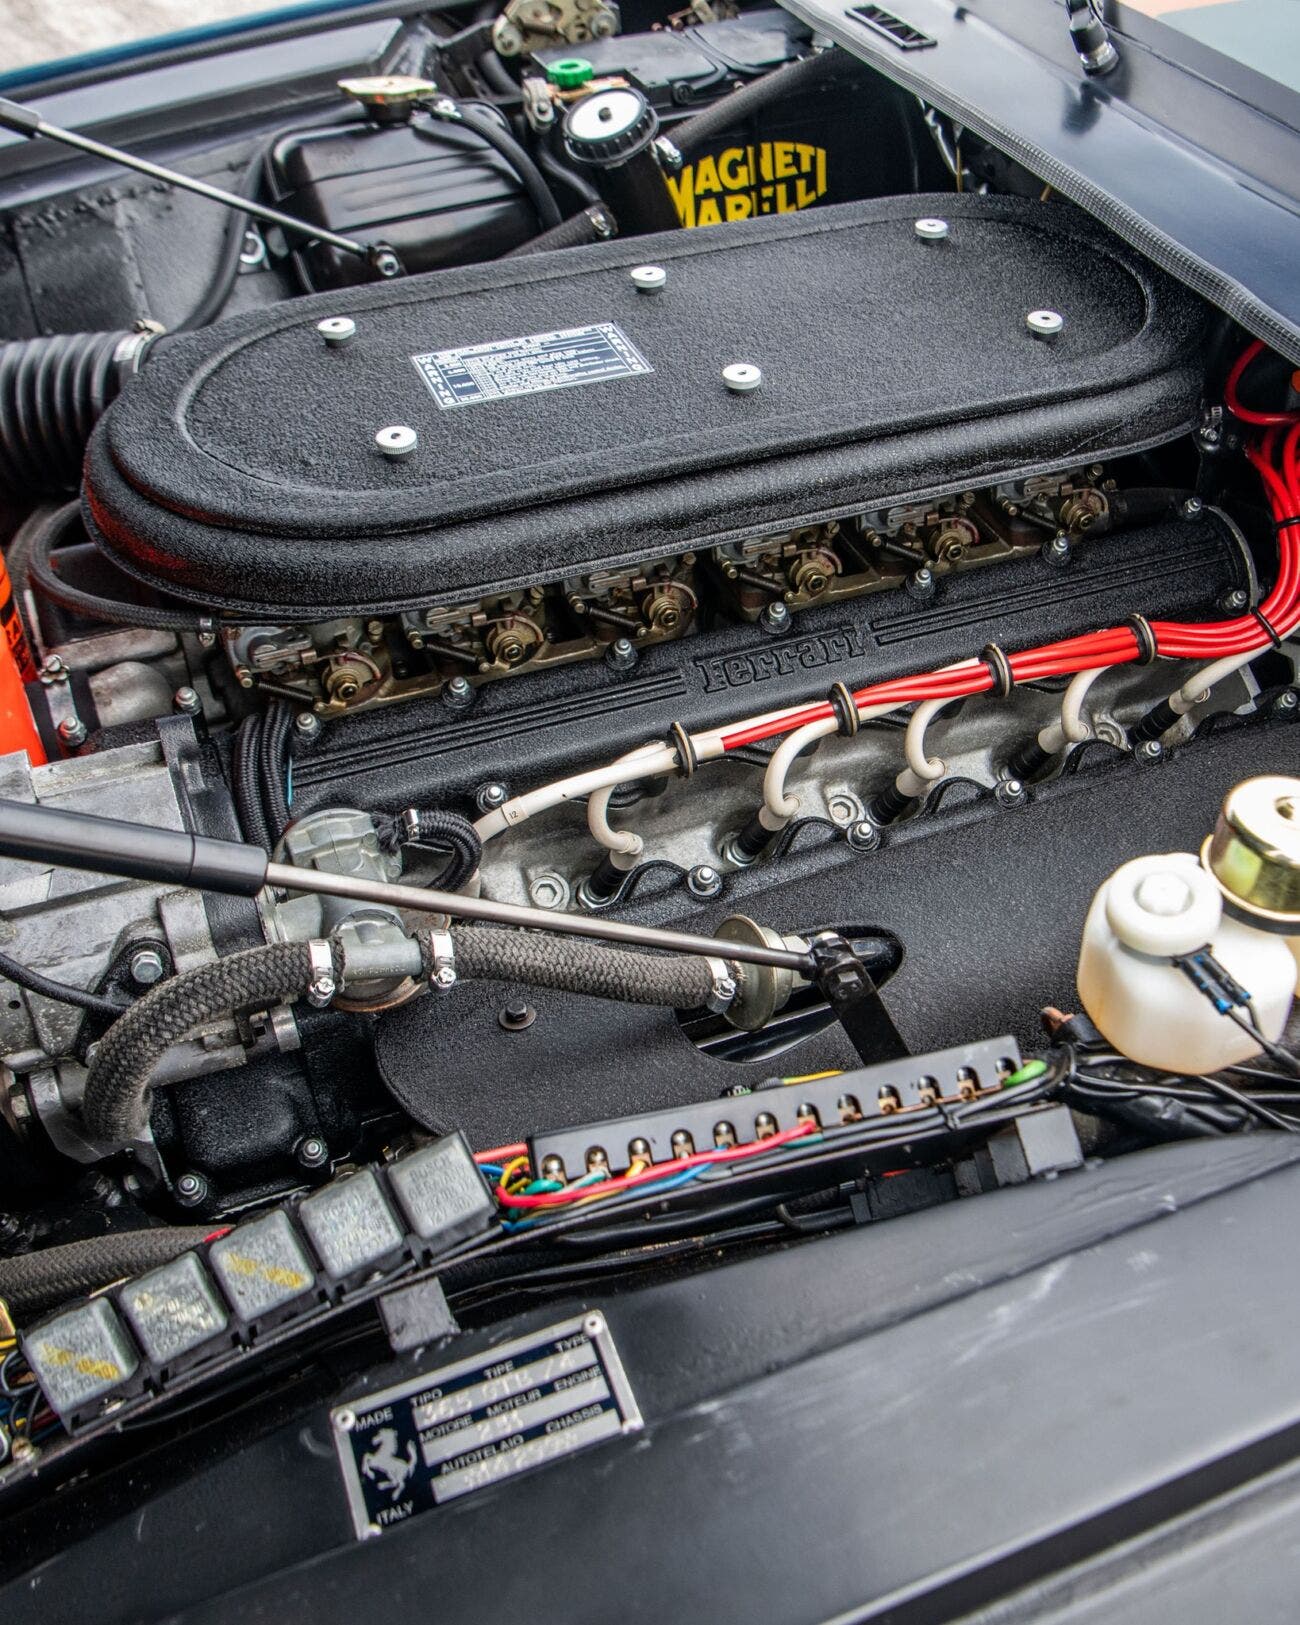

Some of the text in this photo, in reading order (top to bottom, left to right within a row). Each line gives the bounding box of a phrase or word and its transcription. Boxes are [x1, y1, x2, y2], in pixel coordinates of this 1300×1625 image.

[694, 626, 866, 694] Ferrari
[508, 810, 519, 820] 12
[410, 1334, 591, 1407] TIPO TIPE TYPE
[421, 1365, 601, 1442] MOTORE MOTEUR ENGINE
[355, 1406, 394, 1432] MADE
[440, 1434, 525, 1474] AUTOTELAIO
[546, 1403, 603, 1434] CHASSIS
[376, 1501, 414, 1527] ITALY
